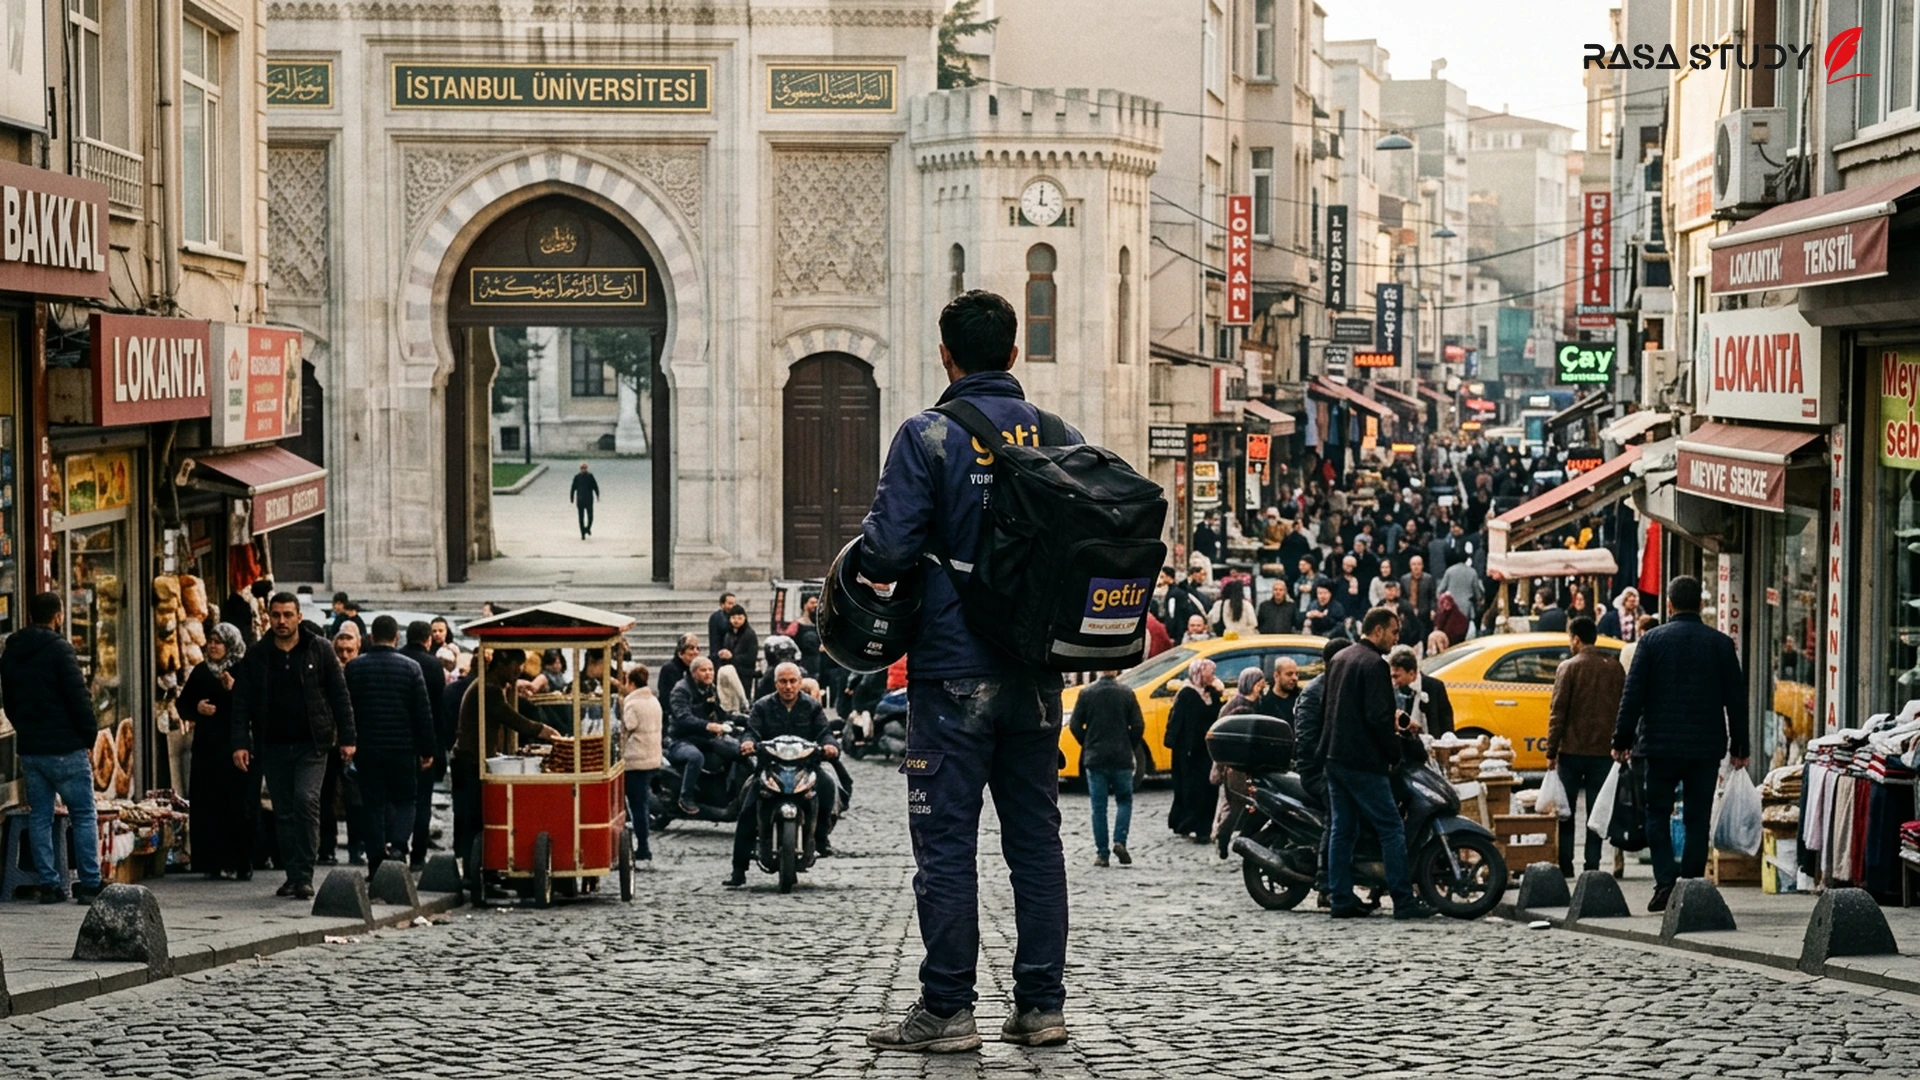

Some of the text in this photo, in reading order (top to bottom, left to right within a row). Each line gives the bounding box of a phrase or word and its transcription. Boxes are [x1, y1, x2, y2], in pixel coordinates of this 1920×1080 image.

[406, 71, 697, 102] İSTANBUL ÜNİVERSİTESİ
[3, 185, 105, 272] BAKKAL
[1803, 226, 1857, 275] TEKSTİL
[114, 336, 206, 403] LOKANTA
[1560, 345, 1614, 373] Çay
[1714, 333, 1804, 394] LOKANTA
[1882, 352, 1920, 408] Mey
[1690, 459, 1727, 493] MEYVE
